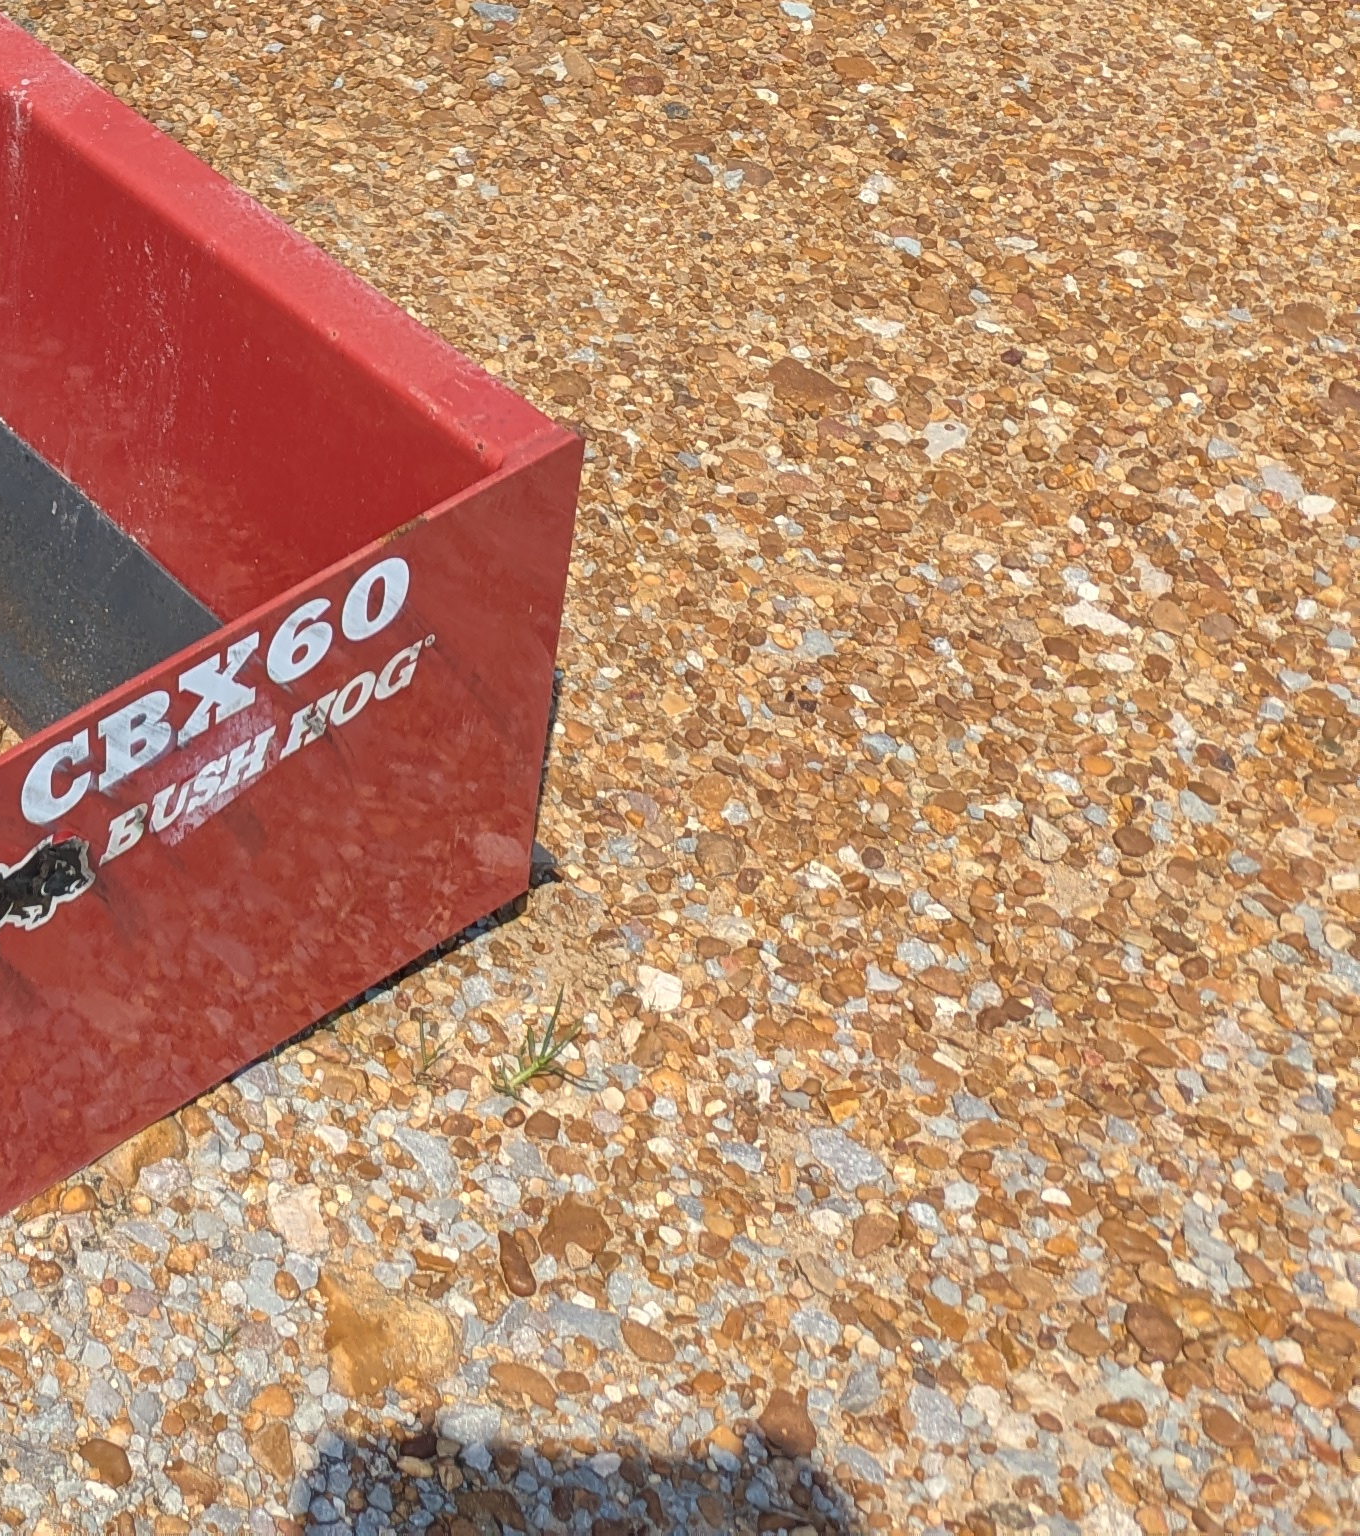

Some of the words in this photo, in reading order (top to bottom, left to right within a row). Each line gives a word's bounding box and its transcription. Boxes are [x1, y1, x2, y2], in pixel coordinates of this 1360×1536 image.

[20, 556, 411, 825] CBX60
[98, 724, 276, 868] BUSH
[281, 638, 424, 759] HOG
